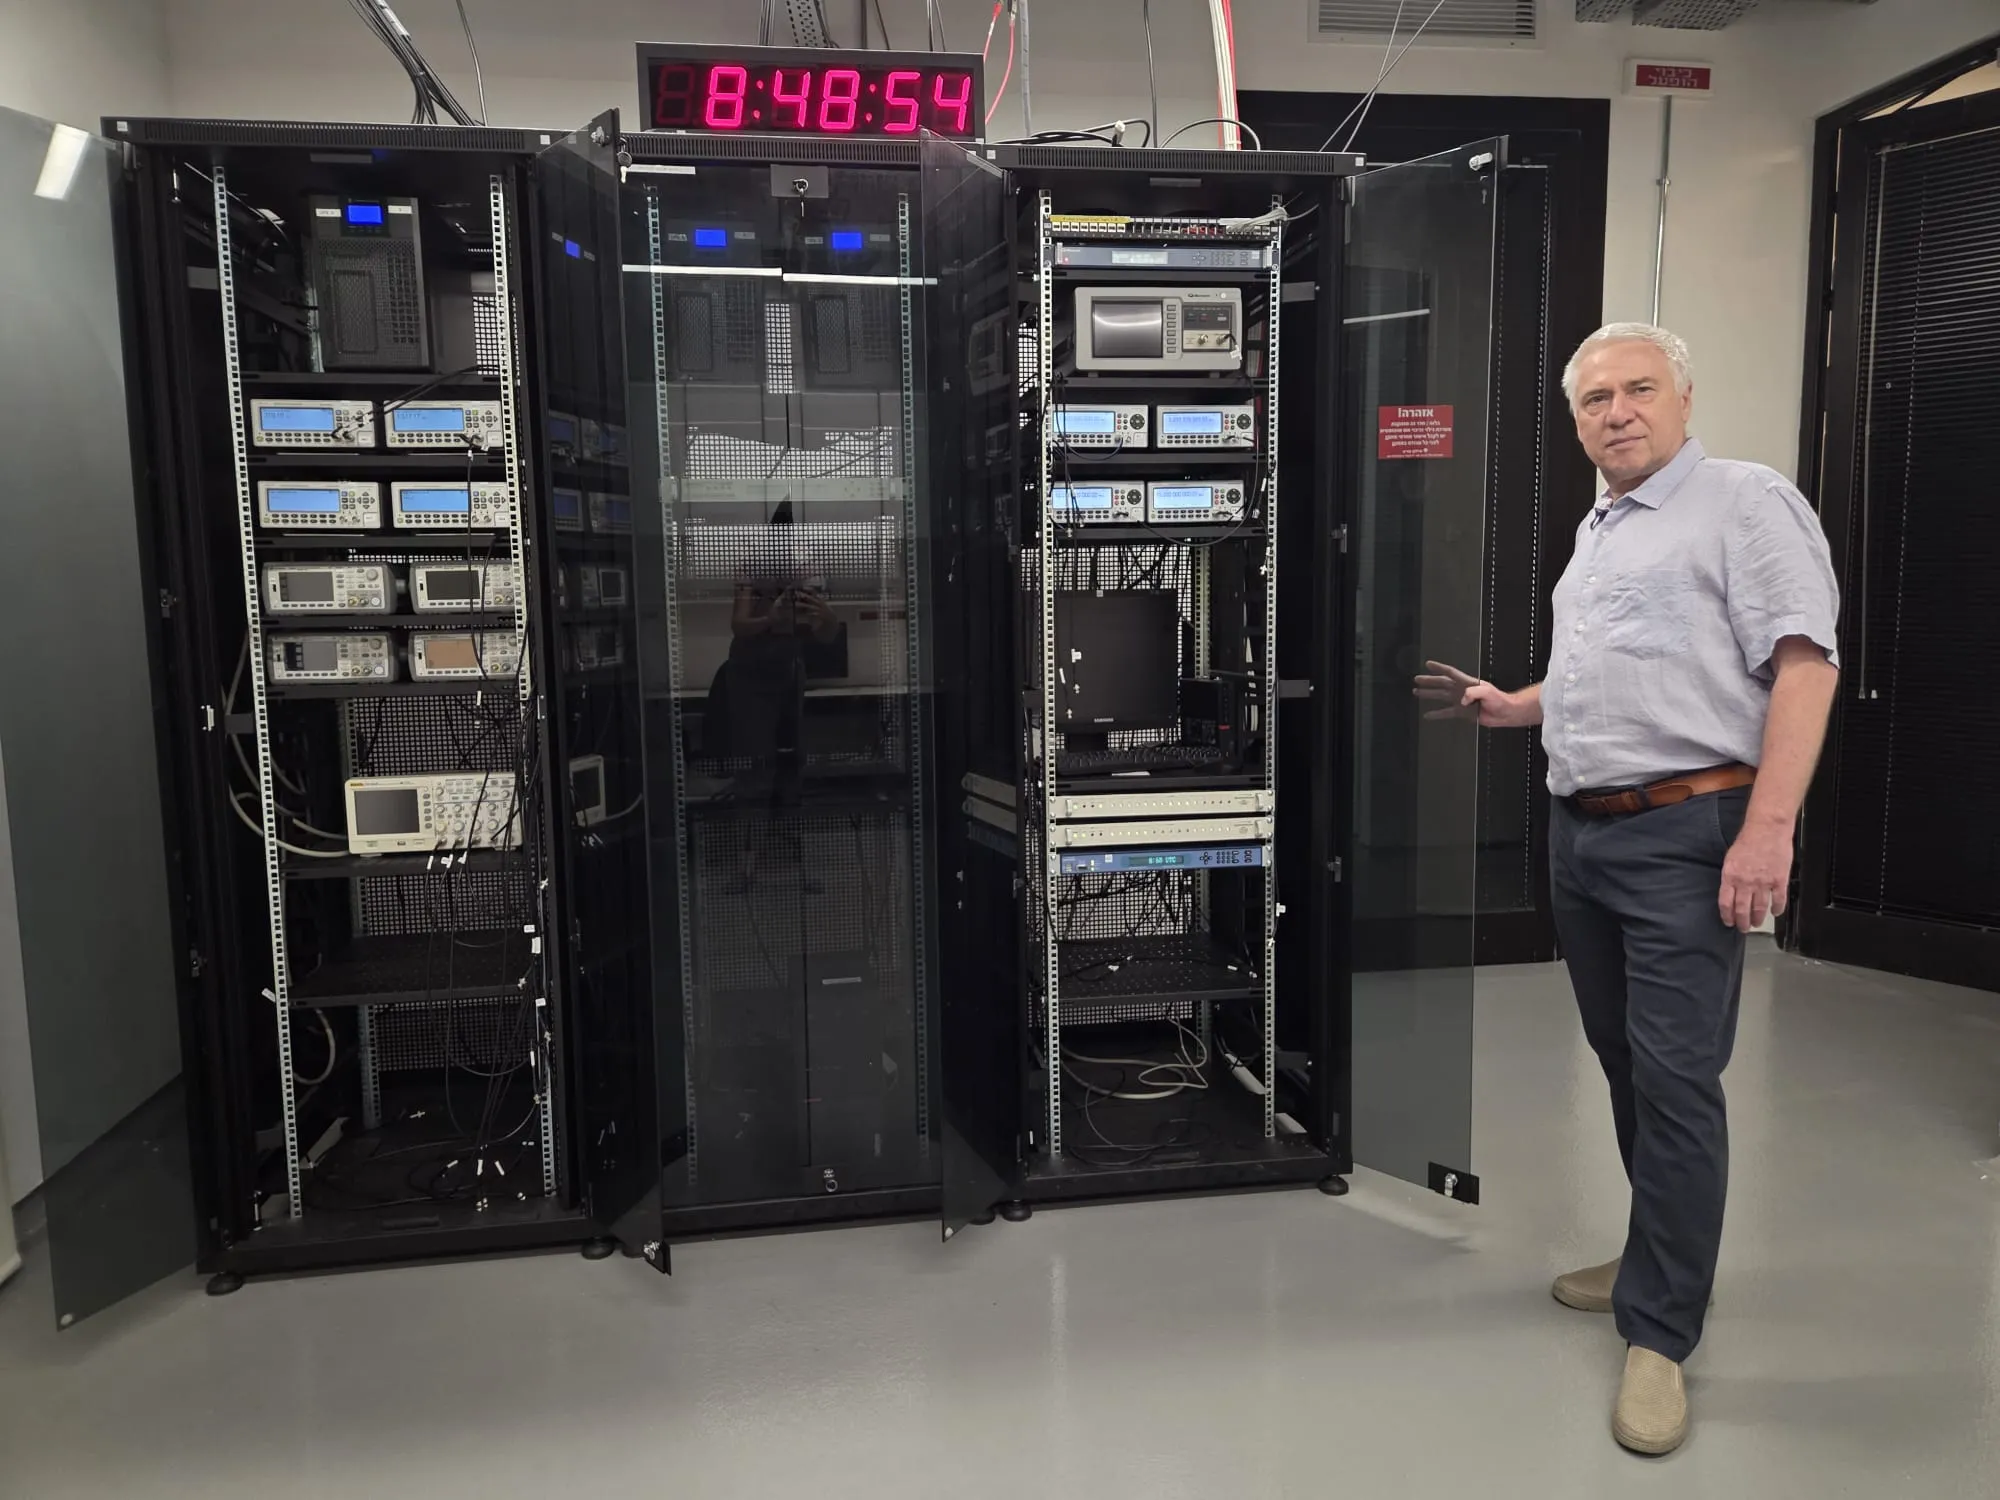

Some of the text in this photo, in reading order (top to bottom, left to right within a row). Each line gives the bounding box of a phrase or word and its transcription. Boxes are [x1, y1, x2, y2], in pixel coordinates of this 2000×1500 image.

[1655, 67, 1692, 78] כיבוי
[1648, 74, 1697, 87] הופעל
[704, 65, 971, 132] 8:48:54
[1397, 408, 1434, 417] אזהרה!
